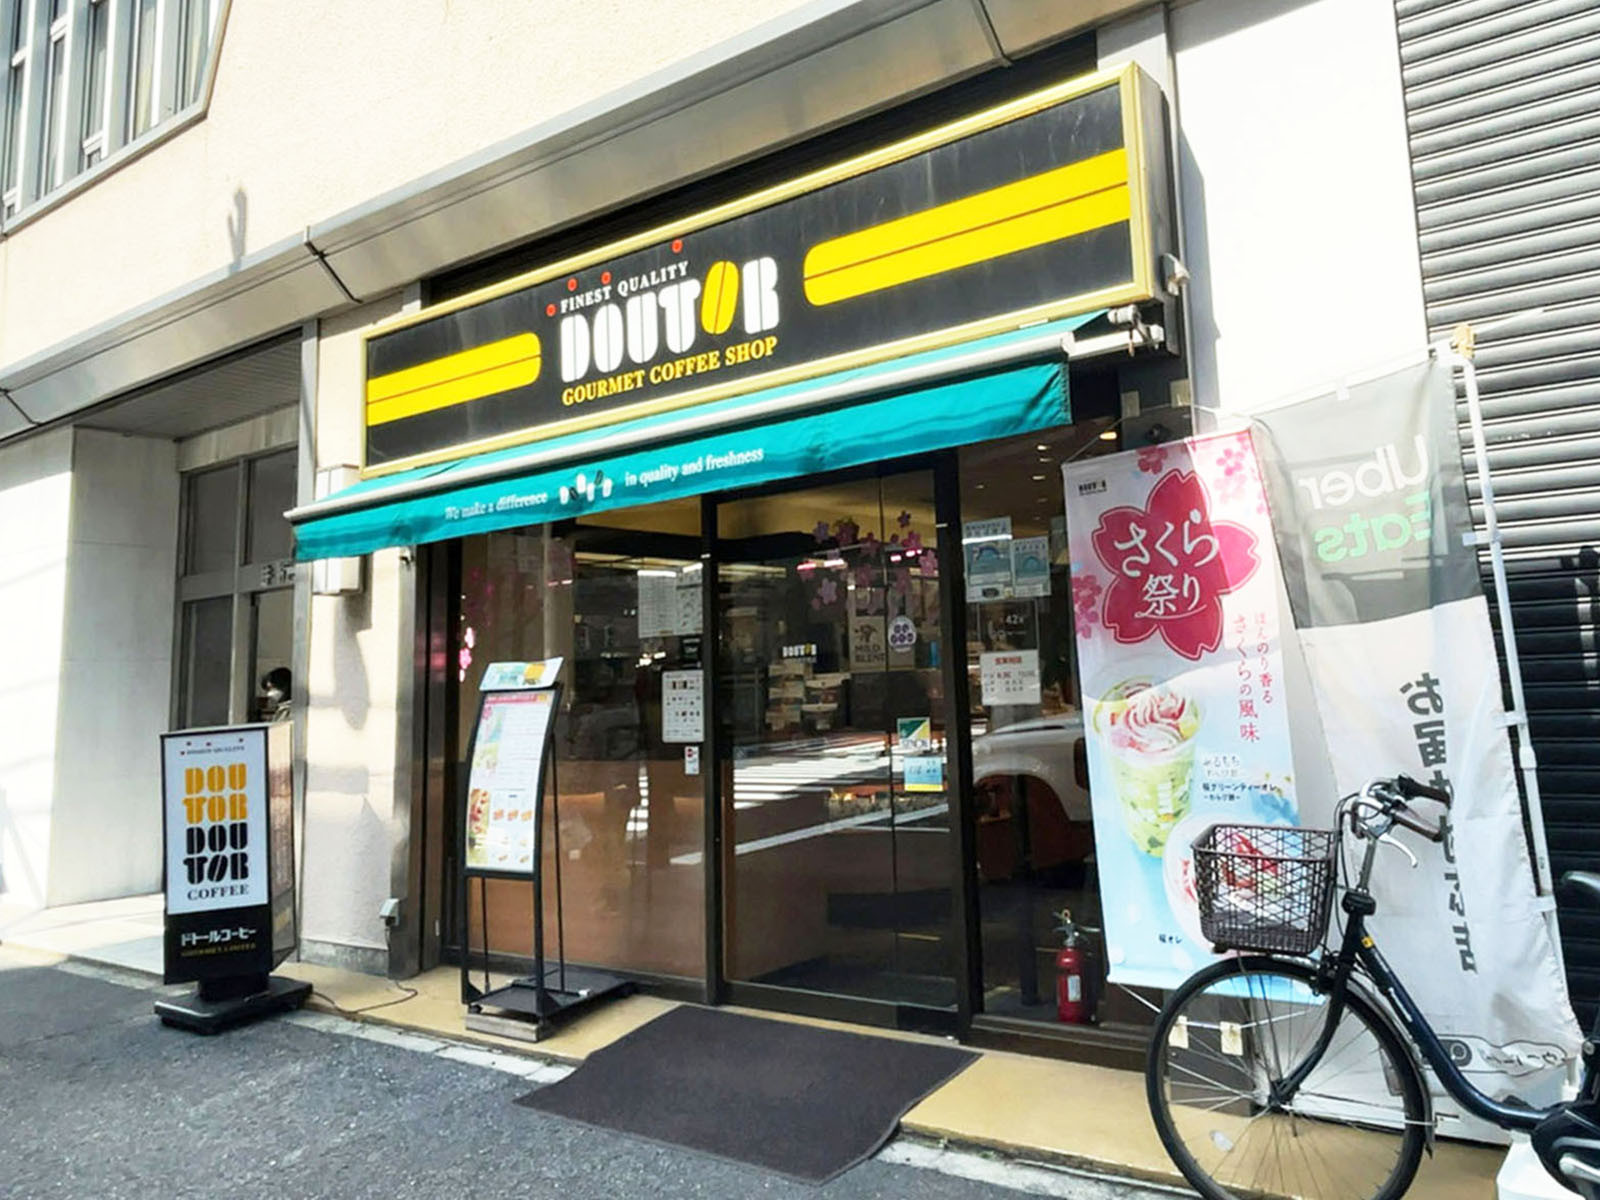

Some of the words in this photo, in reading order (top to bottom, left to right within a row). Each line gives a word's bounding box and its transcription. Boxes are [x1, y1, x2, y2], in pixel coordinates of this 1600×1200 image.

[560, 286, 612, 315] FINEST
[617, 260, 690, 298] QUALITY
[560, 256, 781, 383] DOUTOR
[562, 371, 645, 407] GOURMET
[649, 351, 721, 385] COFFEE
[725, 335, 778, 367] SHOP
[625, 471, 638, 487] in
[639, 464, 680, 488] quality
[681, 456, 703, 476] and
[705, 448, 764, 471] freshness
[495, 492, 548, 512] difference
[1112, 508, 1220, 578] さくら
[1142, 572, 1201, 616] 祭り
[1232, 614, 1261, 744] さくらの風味
[184, 763, 247, 795] DOU
[182, 793, 248, 824] TOR
[185, 822, 248, 855] DOU
[183, 851, 249, 885] TOR
[186, 883, 250, 901] COFFEE
[181, 926, 257, 947] ドトールコーヒー
